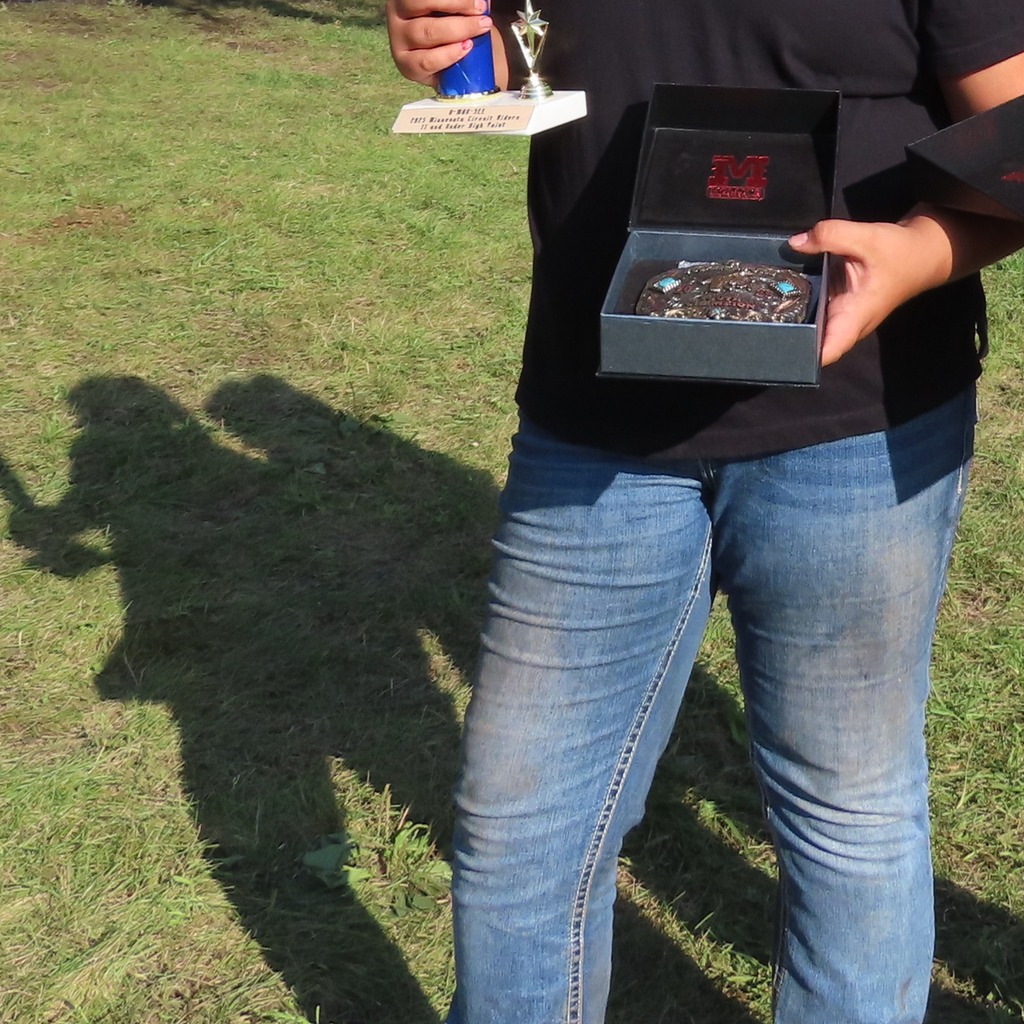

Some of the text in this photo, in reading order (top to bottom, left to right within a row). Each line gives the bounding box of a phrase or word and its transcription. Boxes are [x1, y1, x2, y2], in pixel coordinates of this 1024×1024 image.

[429, 116, 464, 124] Minnesota
[468, 122, 483, 130] High
[486, 121, 506, 129] Point
